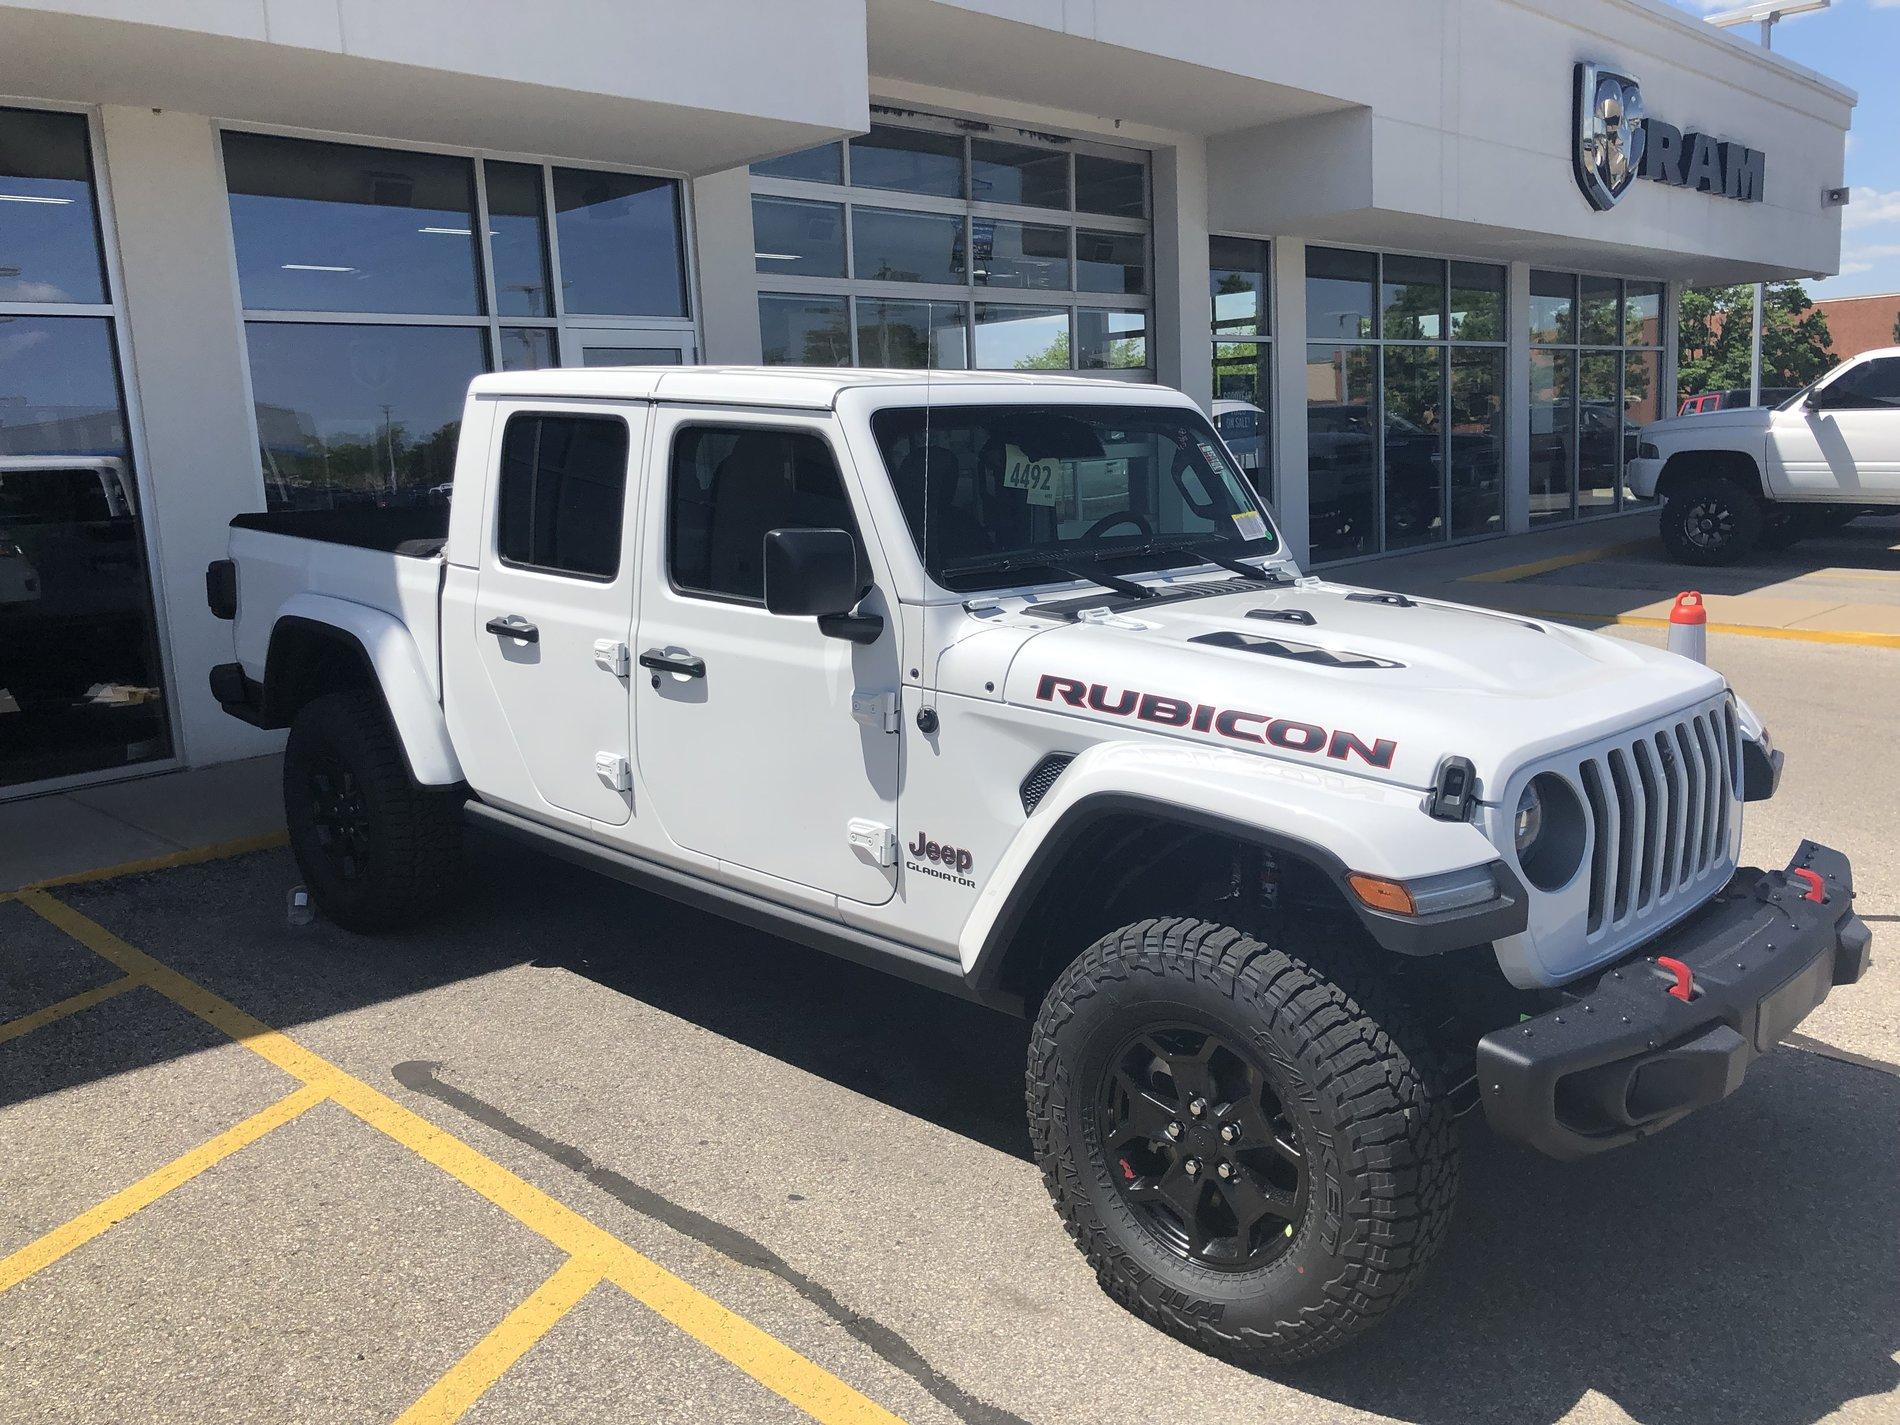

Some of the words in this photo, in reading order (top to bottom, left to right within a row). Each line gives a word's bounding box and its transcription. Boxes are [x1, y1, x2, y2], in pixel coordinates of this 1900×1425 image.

[1637, 117, 1765, 202] RAM
[1010, 462, 1052, 491] 4492
[1035, 674, 1398, 769] RUBICON
[908, 831, 973, 874] Jeep
[906, 861, 976, 889] GLADIATOR
